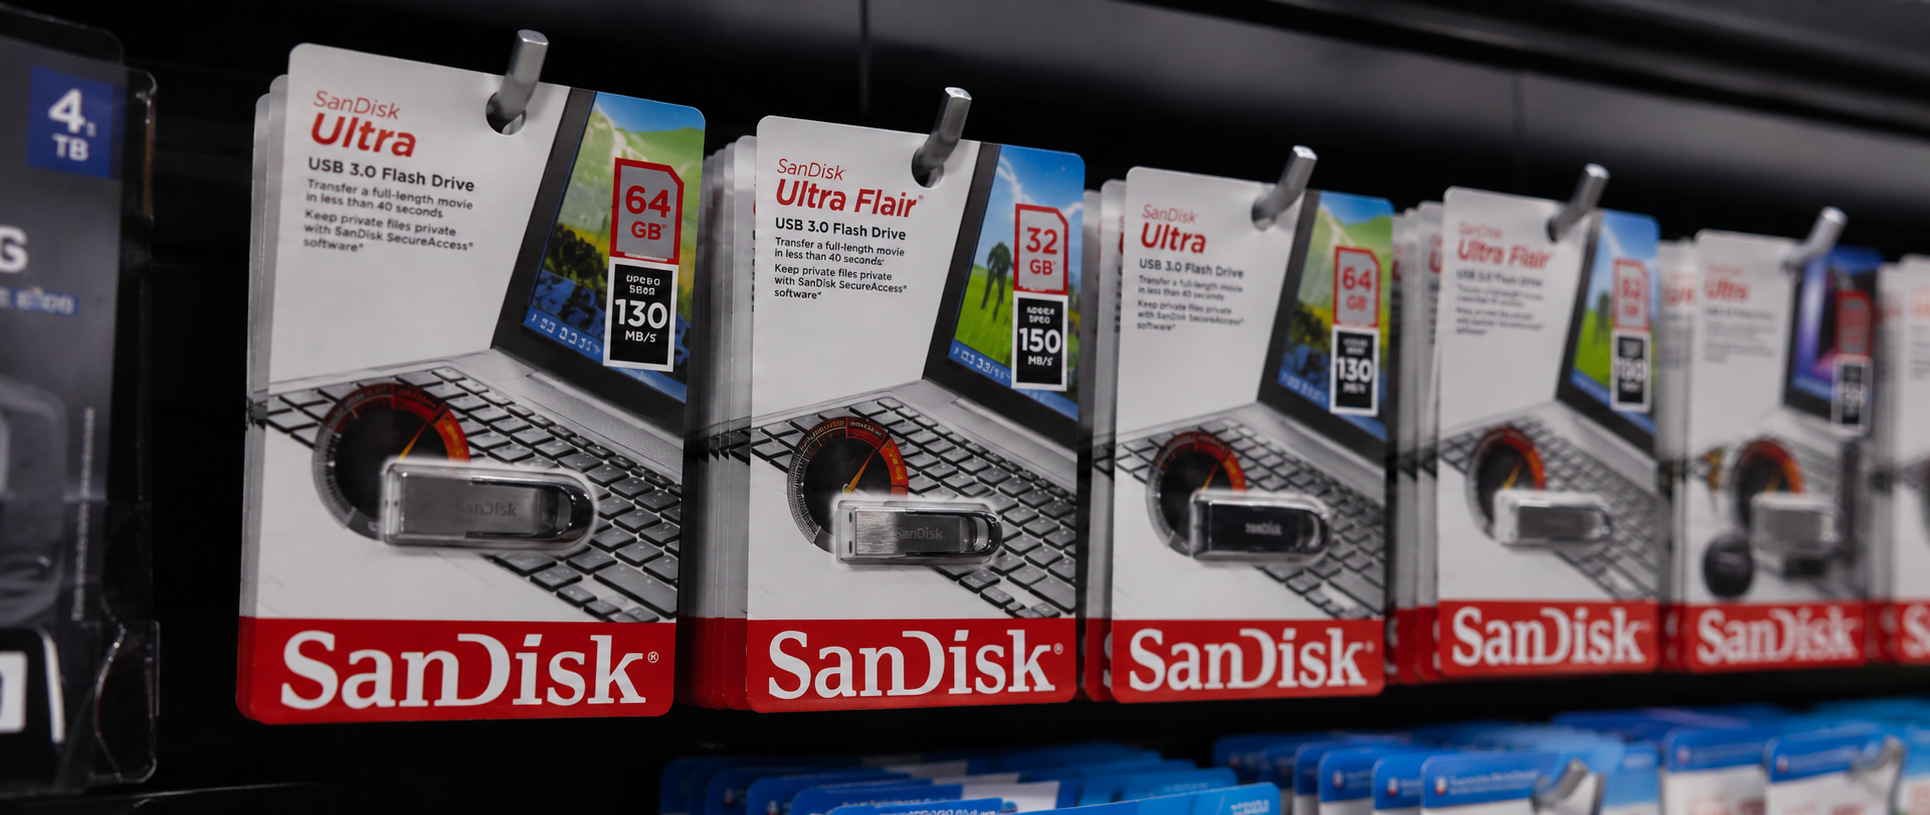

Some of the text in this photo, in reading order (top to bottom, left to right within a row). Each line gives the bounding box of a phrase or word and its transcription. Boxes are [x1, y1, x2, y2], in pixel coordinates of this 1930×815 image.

[313, 90, 400, 120] SanDisk
[52, 133, 90, 162] TB
[311, 112, 417, 158] Ultra
[308, 156, 475, 191] USB 3.0 Flash Drive
[777, 158, 847, 181] SanDisk
[305, 191, 443, 219] in less than 40 seconds
[307, 178, 473, 210] Transfer a full-length movie
[625, 185, 671, 219] 64
[776, 178, 847, 212] Ultra
[304, 210, 457, 237] Keep private files private
[1142, 204, 1197, 225] SanDisk
[303, 223, 331, 236] with
[334, 226, 383, 241] SanDisk
[775, 217, 906, 240] USB 3.0 Flash Drive
[1026, 226, 1058, 255] 32
[1141, 222, 1206, 254] Ultra
[774, 248, 783, 258] in
[785, 249, 803, 260] less
[805, 251, 827, 261] than
[828, 253, 841, 262] 40
[775, 237, 905, 257] Transfer a full-length movie
[1457, 239, 1505, 265] Ultra
[774, 264, 892, 282] Keep private files private
[1139, 258, 1244, 279] USB 3.0 Flash Drive
[1139, 275, 1170, 286] Transfer
[1342, 267, 1372, 292] 64
[774, 276, 795, 286] with
[798, 277, 836, 289] SanDisk
[1138, 286, 1145, 294] in
[1147, 286, 1161, 295] less
[1163, 288, 1180, 297] than
[1182, 290, 1192, 298] 40
[615, 298, 668, 329] 130
[1137, 300, 1158, 309] Keep
[1160, 302, 1186, 311] private
[1137, 311, 1154, 319] with
[625, 330, 657, 343] MB/S
[1019, 327, 1062, 354] 150
[1027, 355, 1054, 367] MB/S
[1338, 356, 1372, 383] 130
[897, 527, 944, 540] SanDisk
[1452, 606, 1646, 667] SanDisk
[1696, 605, 1859, 665] SanDisk
